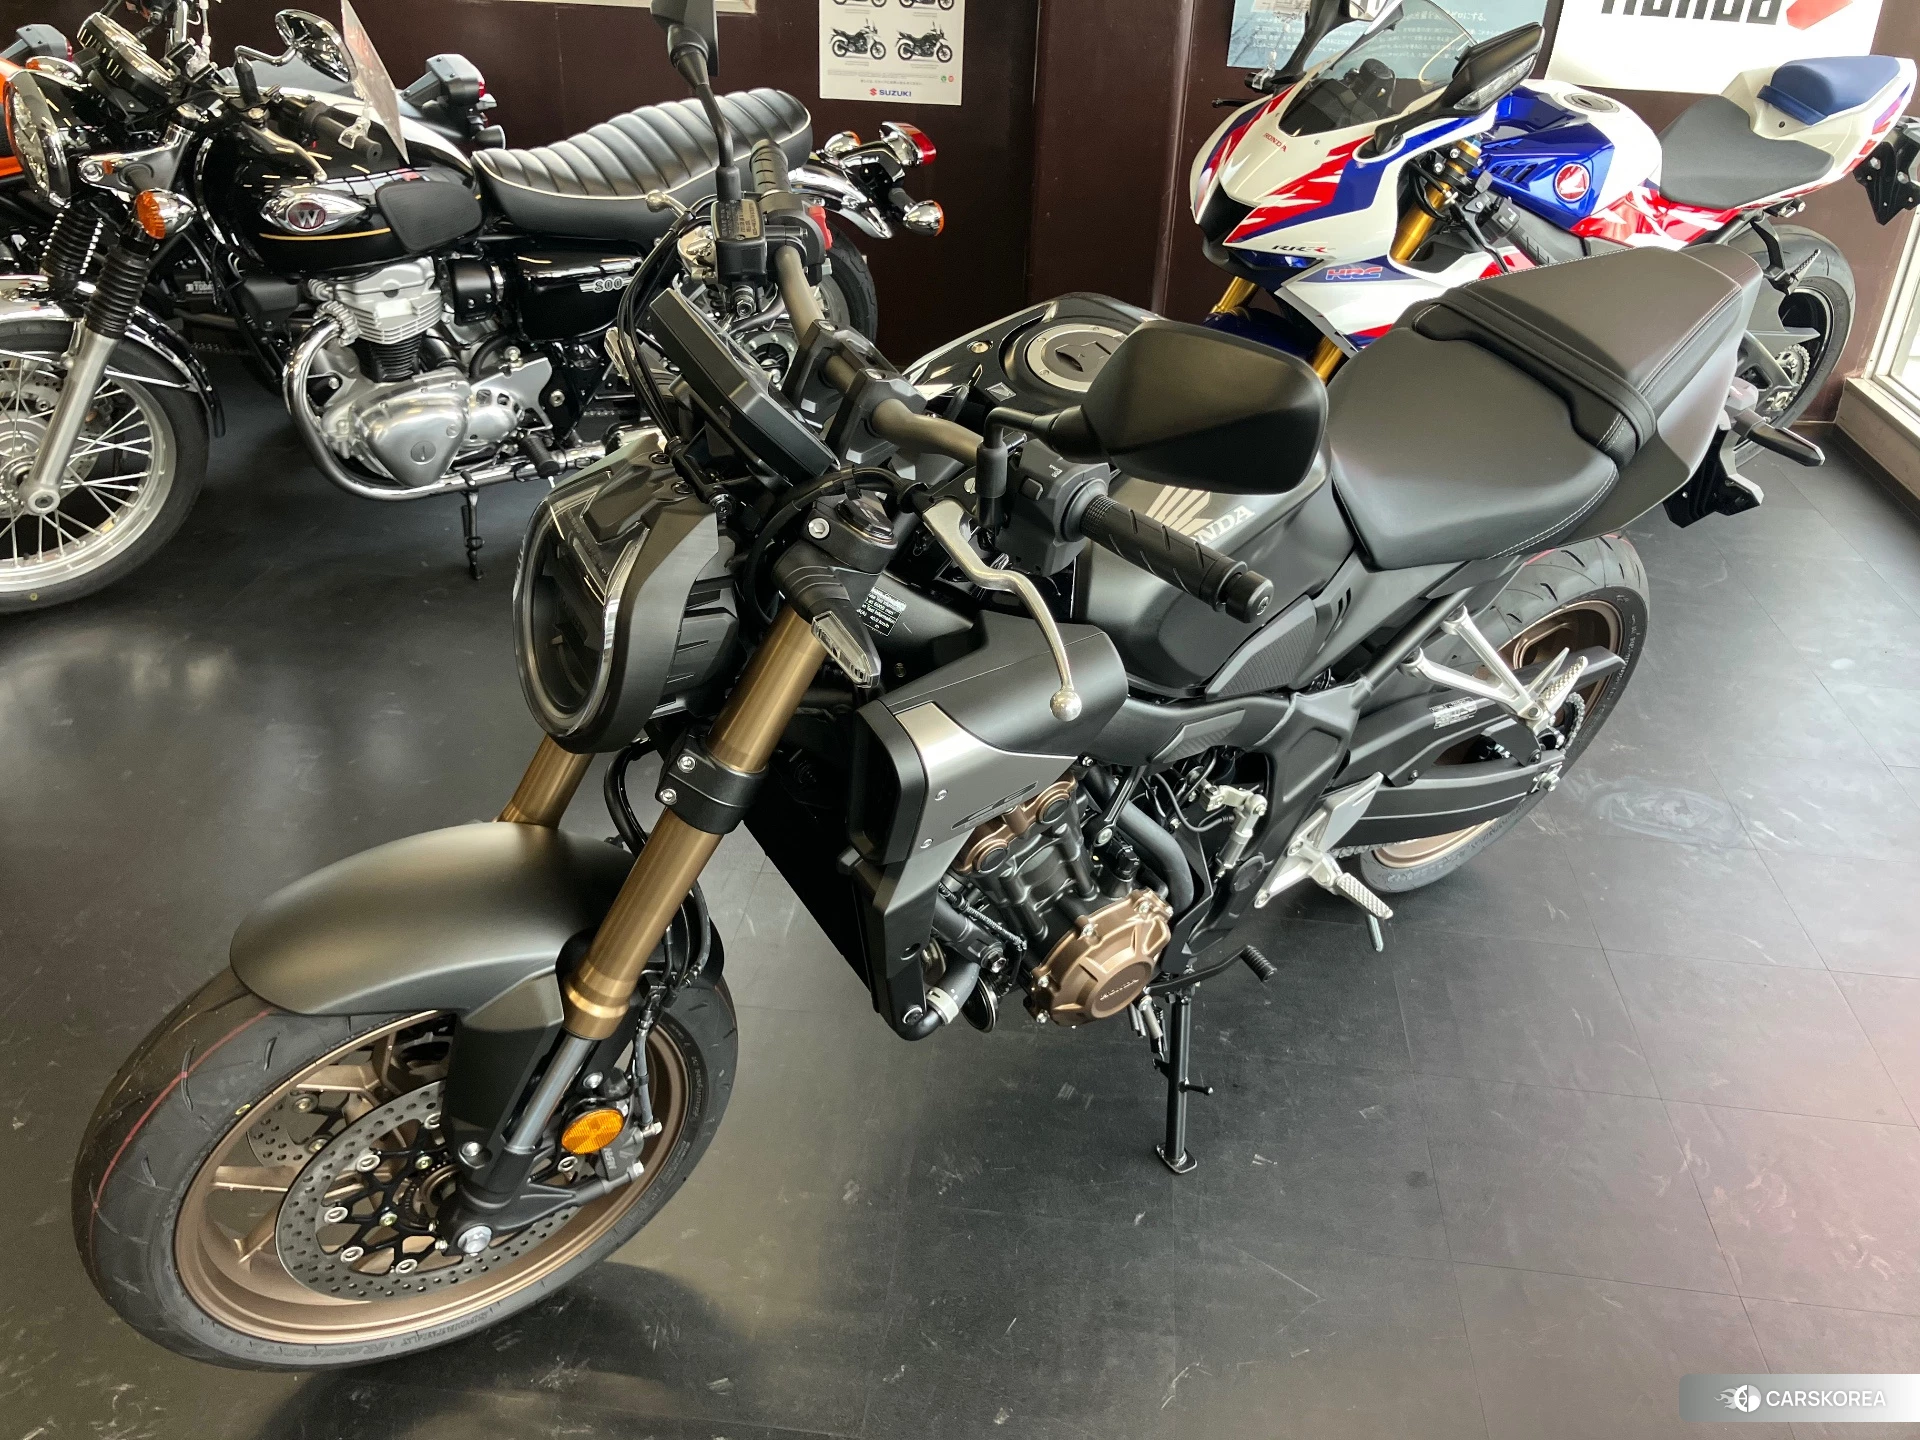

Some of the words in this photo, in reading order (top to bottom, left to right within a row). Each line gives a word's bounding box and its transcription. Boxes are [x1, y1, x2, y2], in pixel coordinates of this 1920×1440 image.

[879, 89, 912, 97] SUZUKI
[295, 209, 321, 228] W
[1325, 266, 1383, 281] HRC
[1190, 504, 1256, 546] NDA
